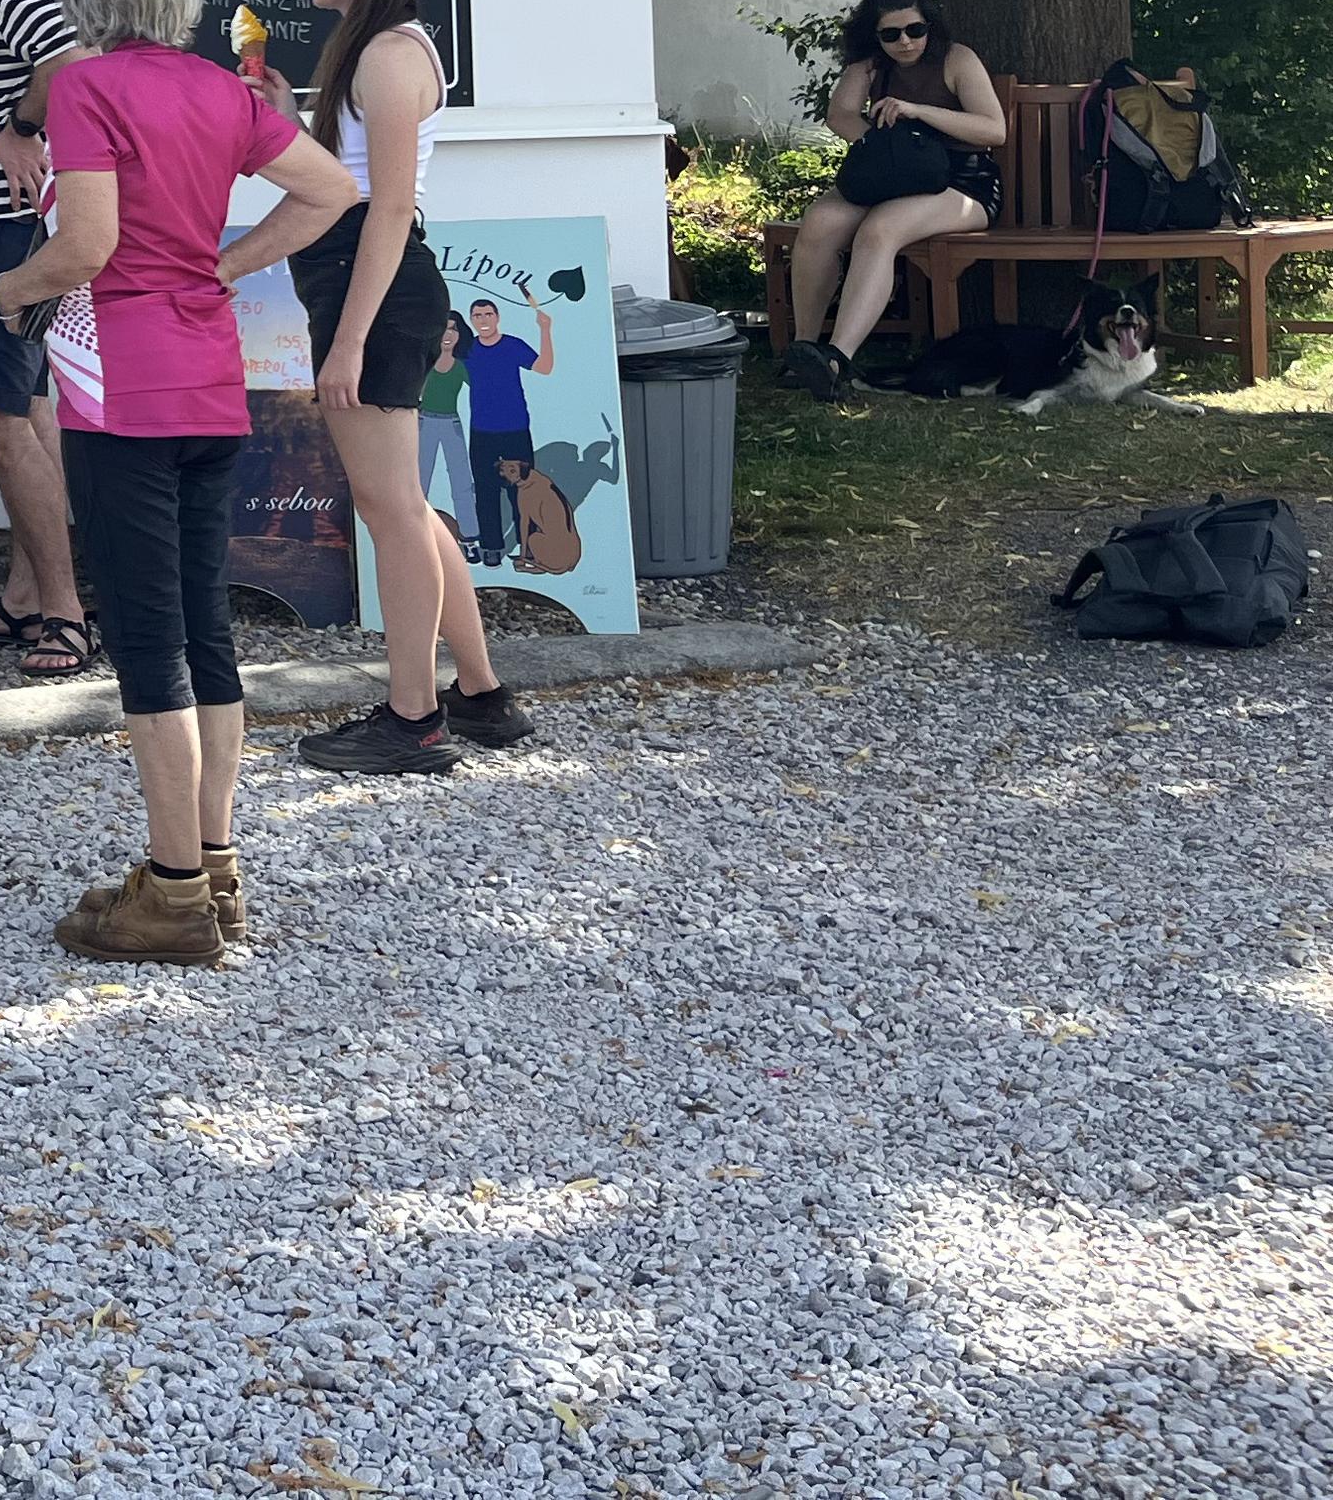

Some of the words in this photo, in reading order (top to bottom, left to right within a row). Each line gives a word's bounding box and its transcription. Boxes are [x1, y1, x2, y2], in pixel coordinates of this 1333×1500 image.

[438, 246, 533, 285] Lípou
[245, 497, 259, 511] s
[265, 486, 337, 511] sebou
